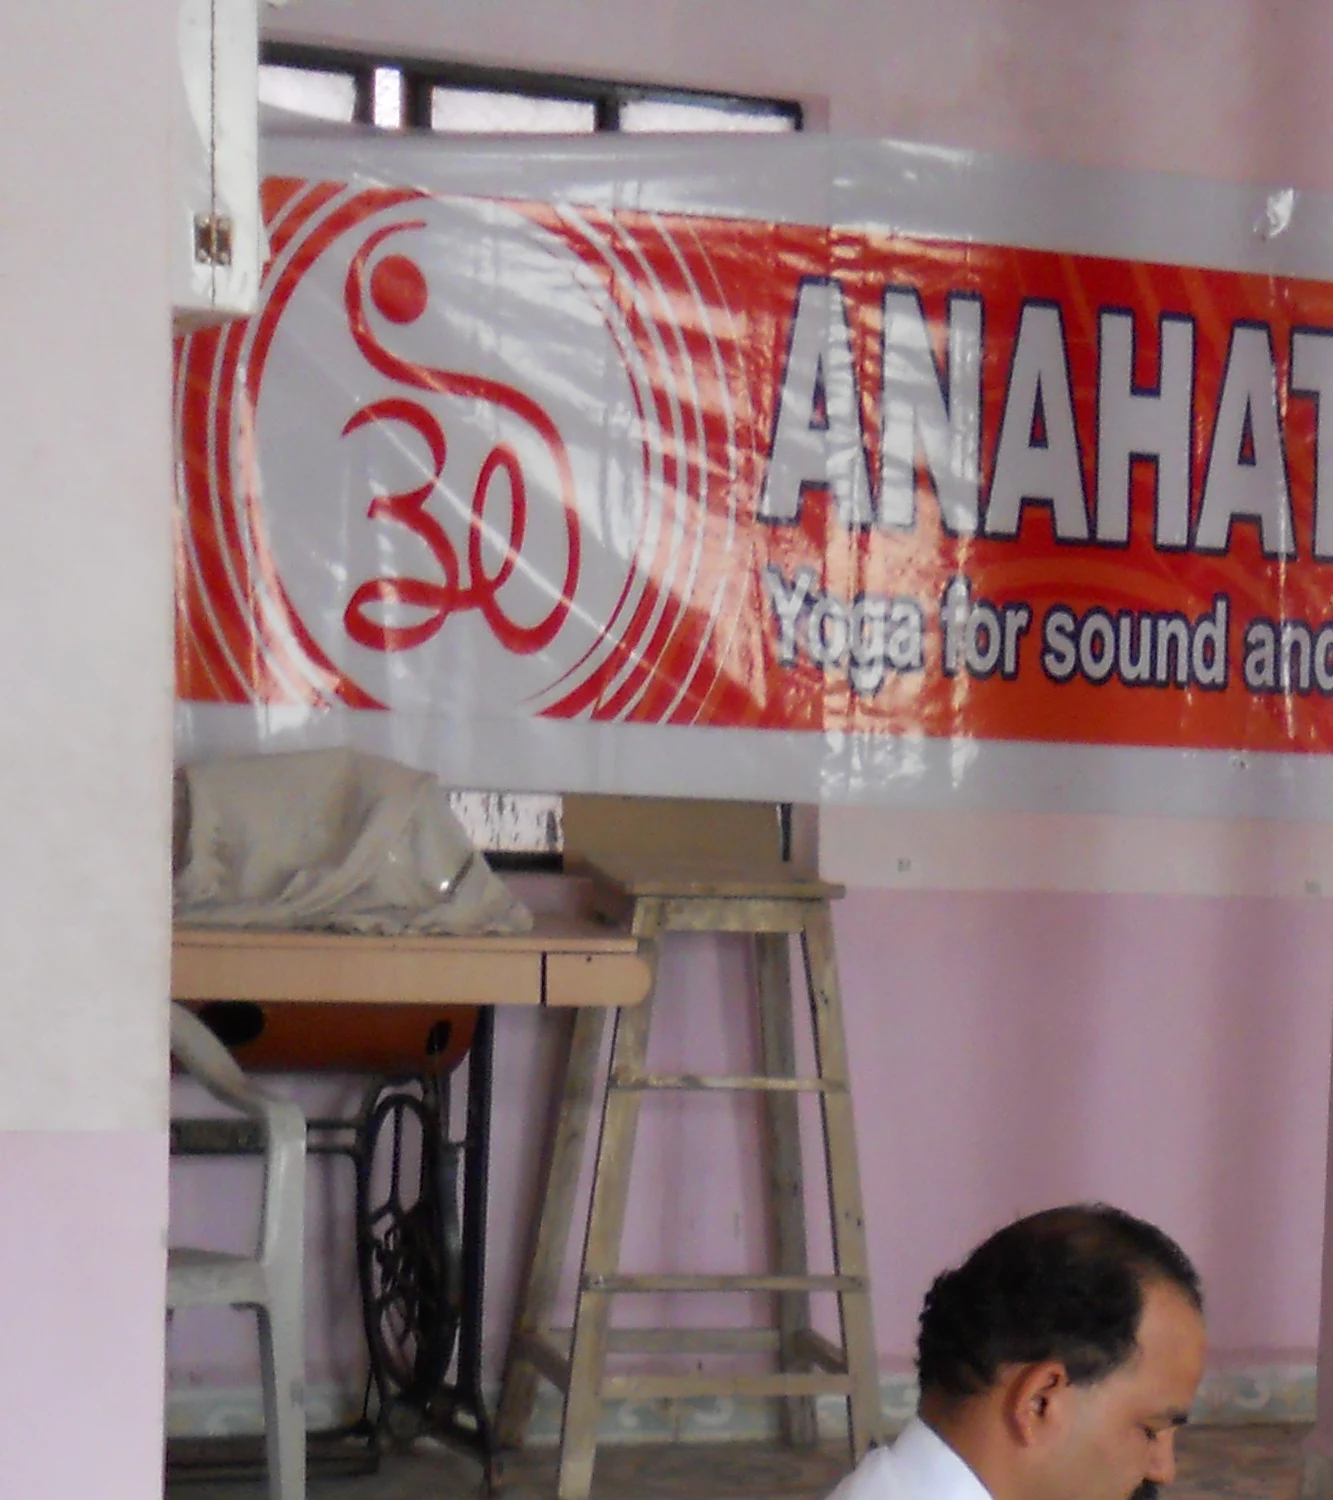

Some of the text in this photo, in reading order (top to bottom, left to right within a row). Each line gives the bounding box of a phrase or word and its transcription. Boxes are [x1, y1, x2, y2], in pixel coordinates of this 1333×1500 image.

[762, 566, 924, 698] Yoga
[941, 577, 1031, 683] for
[1041, 594, 1229, 690] sound
